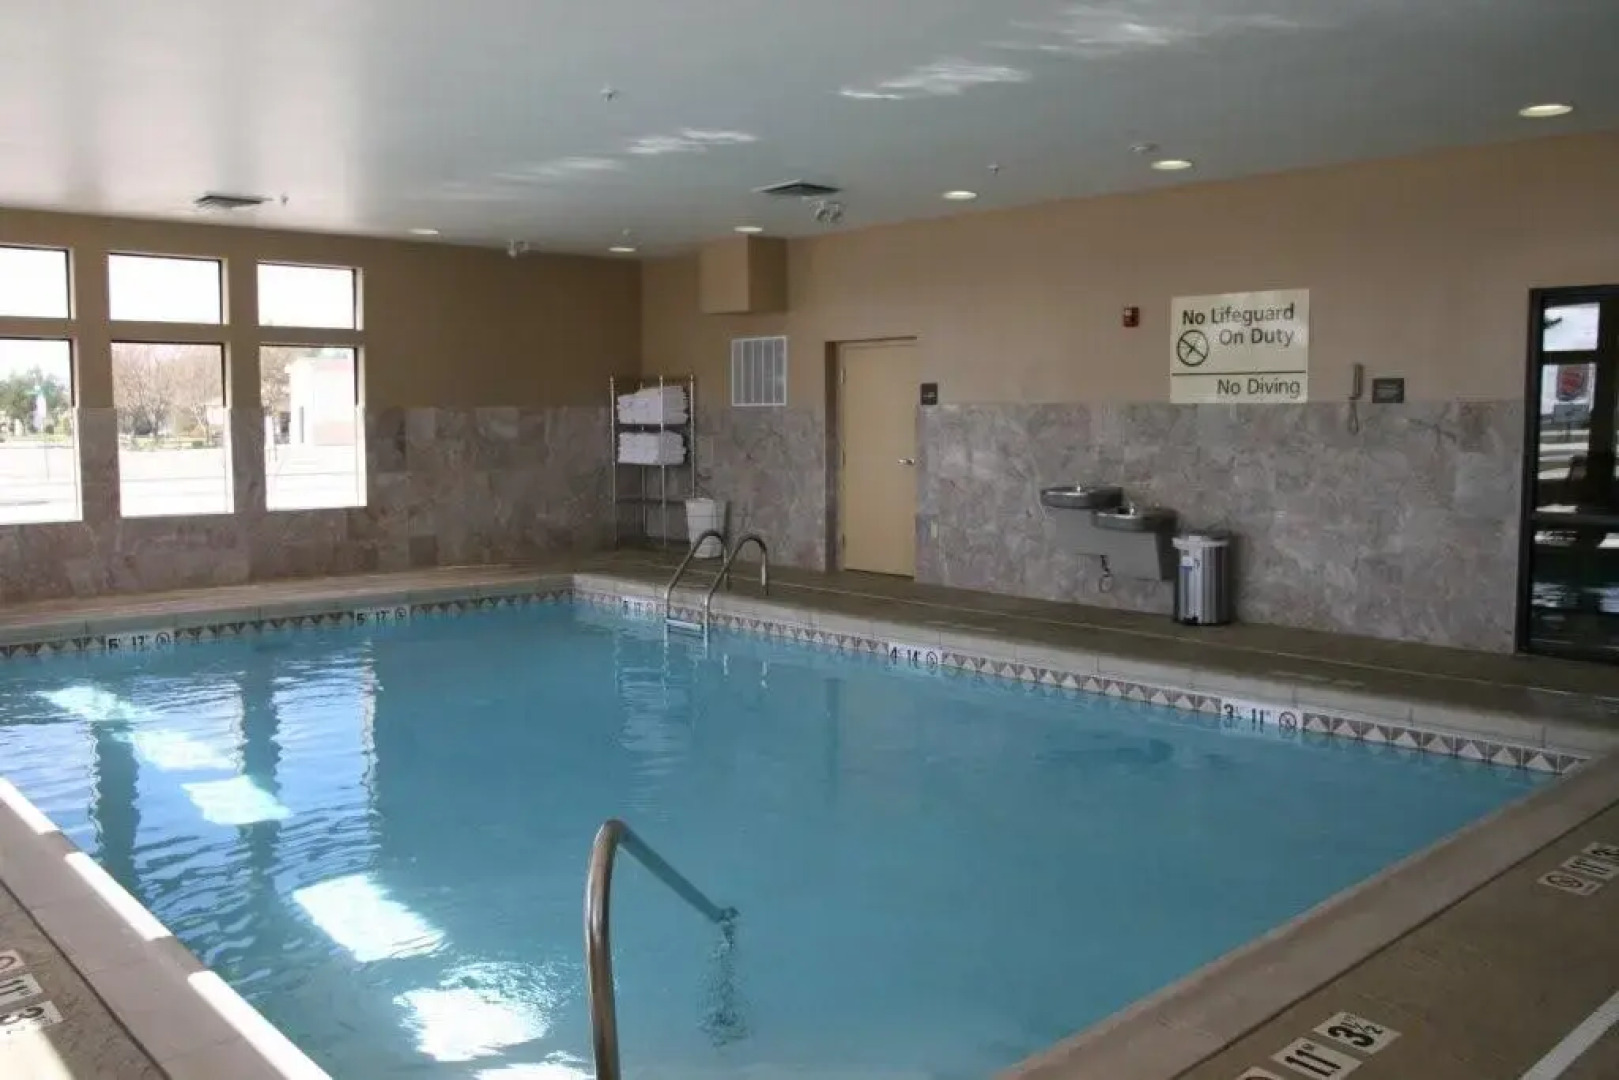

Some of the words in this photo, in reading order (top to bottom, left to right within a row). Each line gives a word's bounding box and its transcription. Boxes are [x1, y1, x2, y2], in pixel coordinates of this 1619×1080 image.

[1182, 309, 1205, 325] No
[1210, 303, 1294, 327] Lifeguard
[1219, 329, 1243, 345] On
[1251, 328, 1294, 348] Duty
[1217, 379, 1241, 395] No
[1247, 377, 1300, 399] Diving
